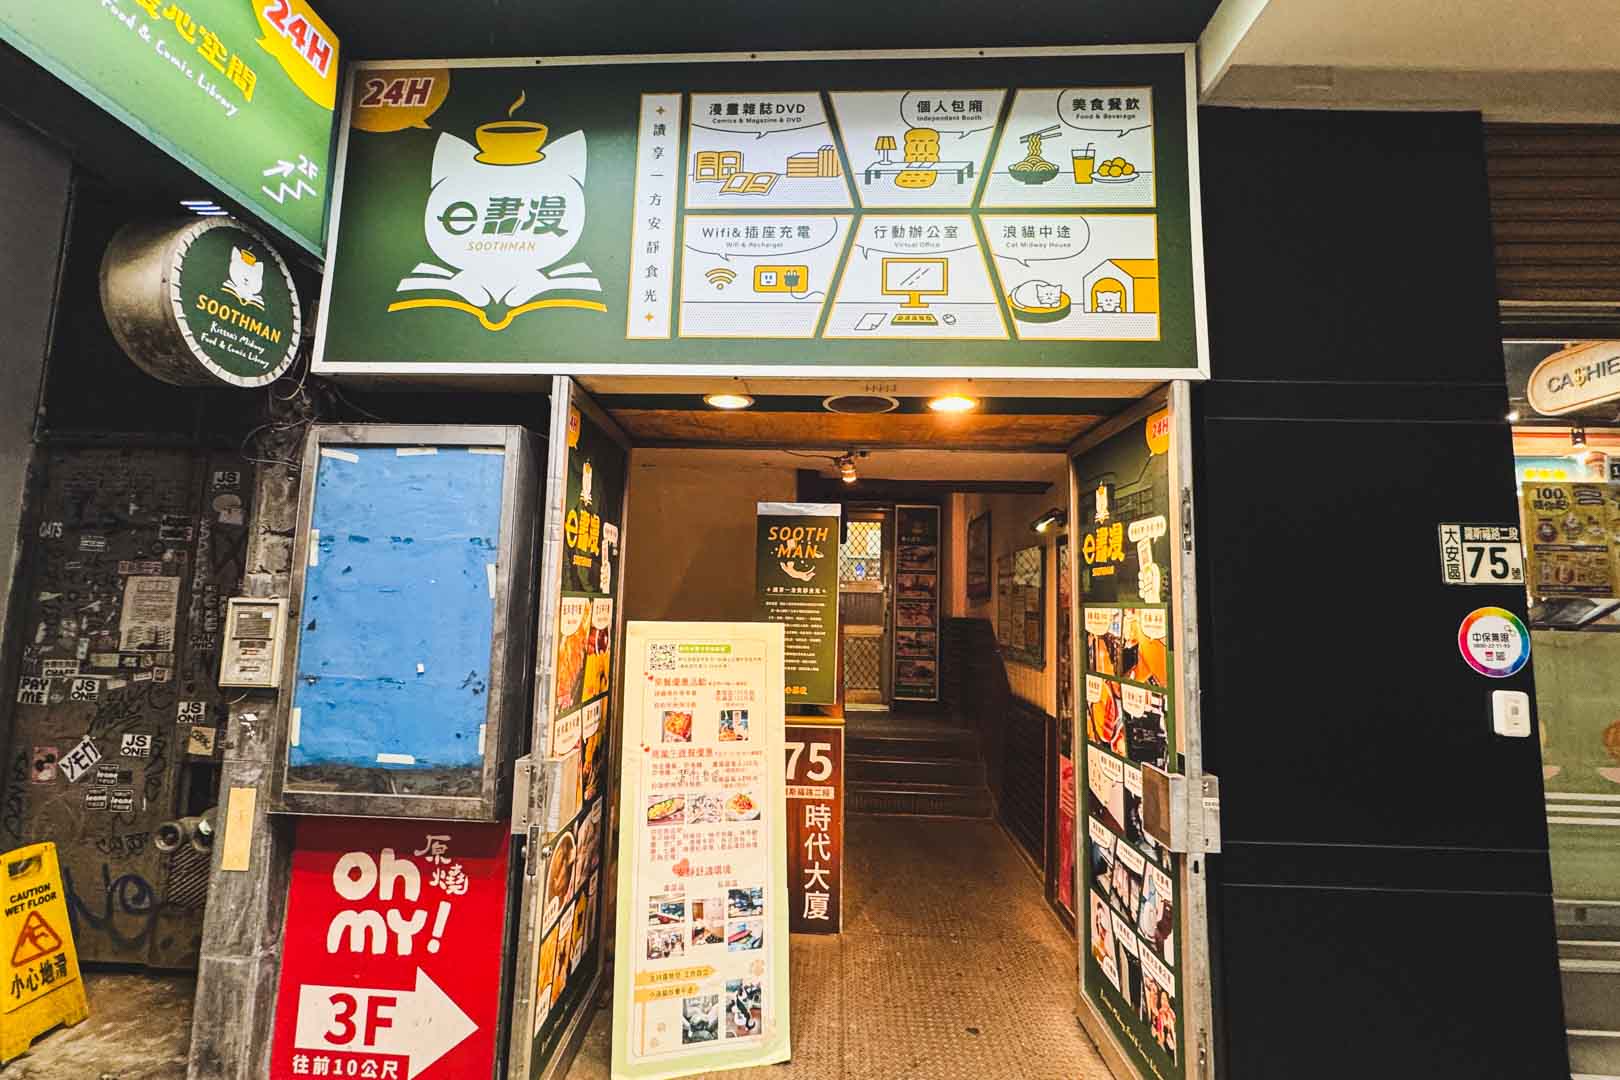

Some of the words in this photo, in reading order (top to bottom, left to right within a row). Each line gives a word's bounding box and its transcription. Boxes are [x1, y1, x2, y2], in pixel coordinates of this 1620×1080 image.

[265, 0, 332, 77] 24H
[360, 77, 435, 108] 24H
[917, 99, 983, 114] 個人包廂
[1072, 98, 1140, 111] 美食餐飲
[298, 154, 319, 180] 2F
[874, 225, 959, 239] 行動辦公室
[1003, 225, 1071, 239] 浪貓中途
[467, 240, 536, 252] SOOTHMAN
[196, 294, 281, 343] SOOTHMAN
[768, 527, 828, 542] SOOTH
[777, 544, 816, 559] MAN
[1444, 528, 1461, 580] 大安區
[1466, 547, 1509, 579] 75
[22, 678, 48, 691] PAY
[76, 680, 96, 691] JS
[21, 692, 44, 703] ME
[72, 692, 97, 700] ONE
[182, 703, 202, 713] JS
[178, 714, 204, 722] ONE
[126, 736, 147, 747] JS
[121, 747, 149, 756] ONE
[785, 742, 833, 781] 75
[803, 803, 832, 920] 時代大廈
[10, 882, 51, 903] CAUTION
[5, 902, 25, 917] WET
[27, 891, 57, 909] FLOOR
[11, 952, 67, 999] 小心地滑
[323, 993, 398, 1046] 3F
[292, 1054, 399, 1080] 往前10公尺
